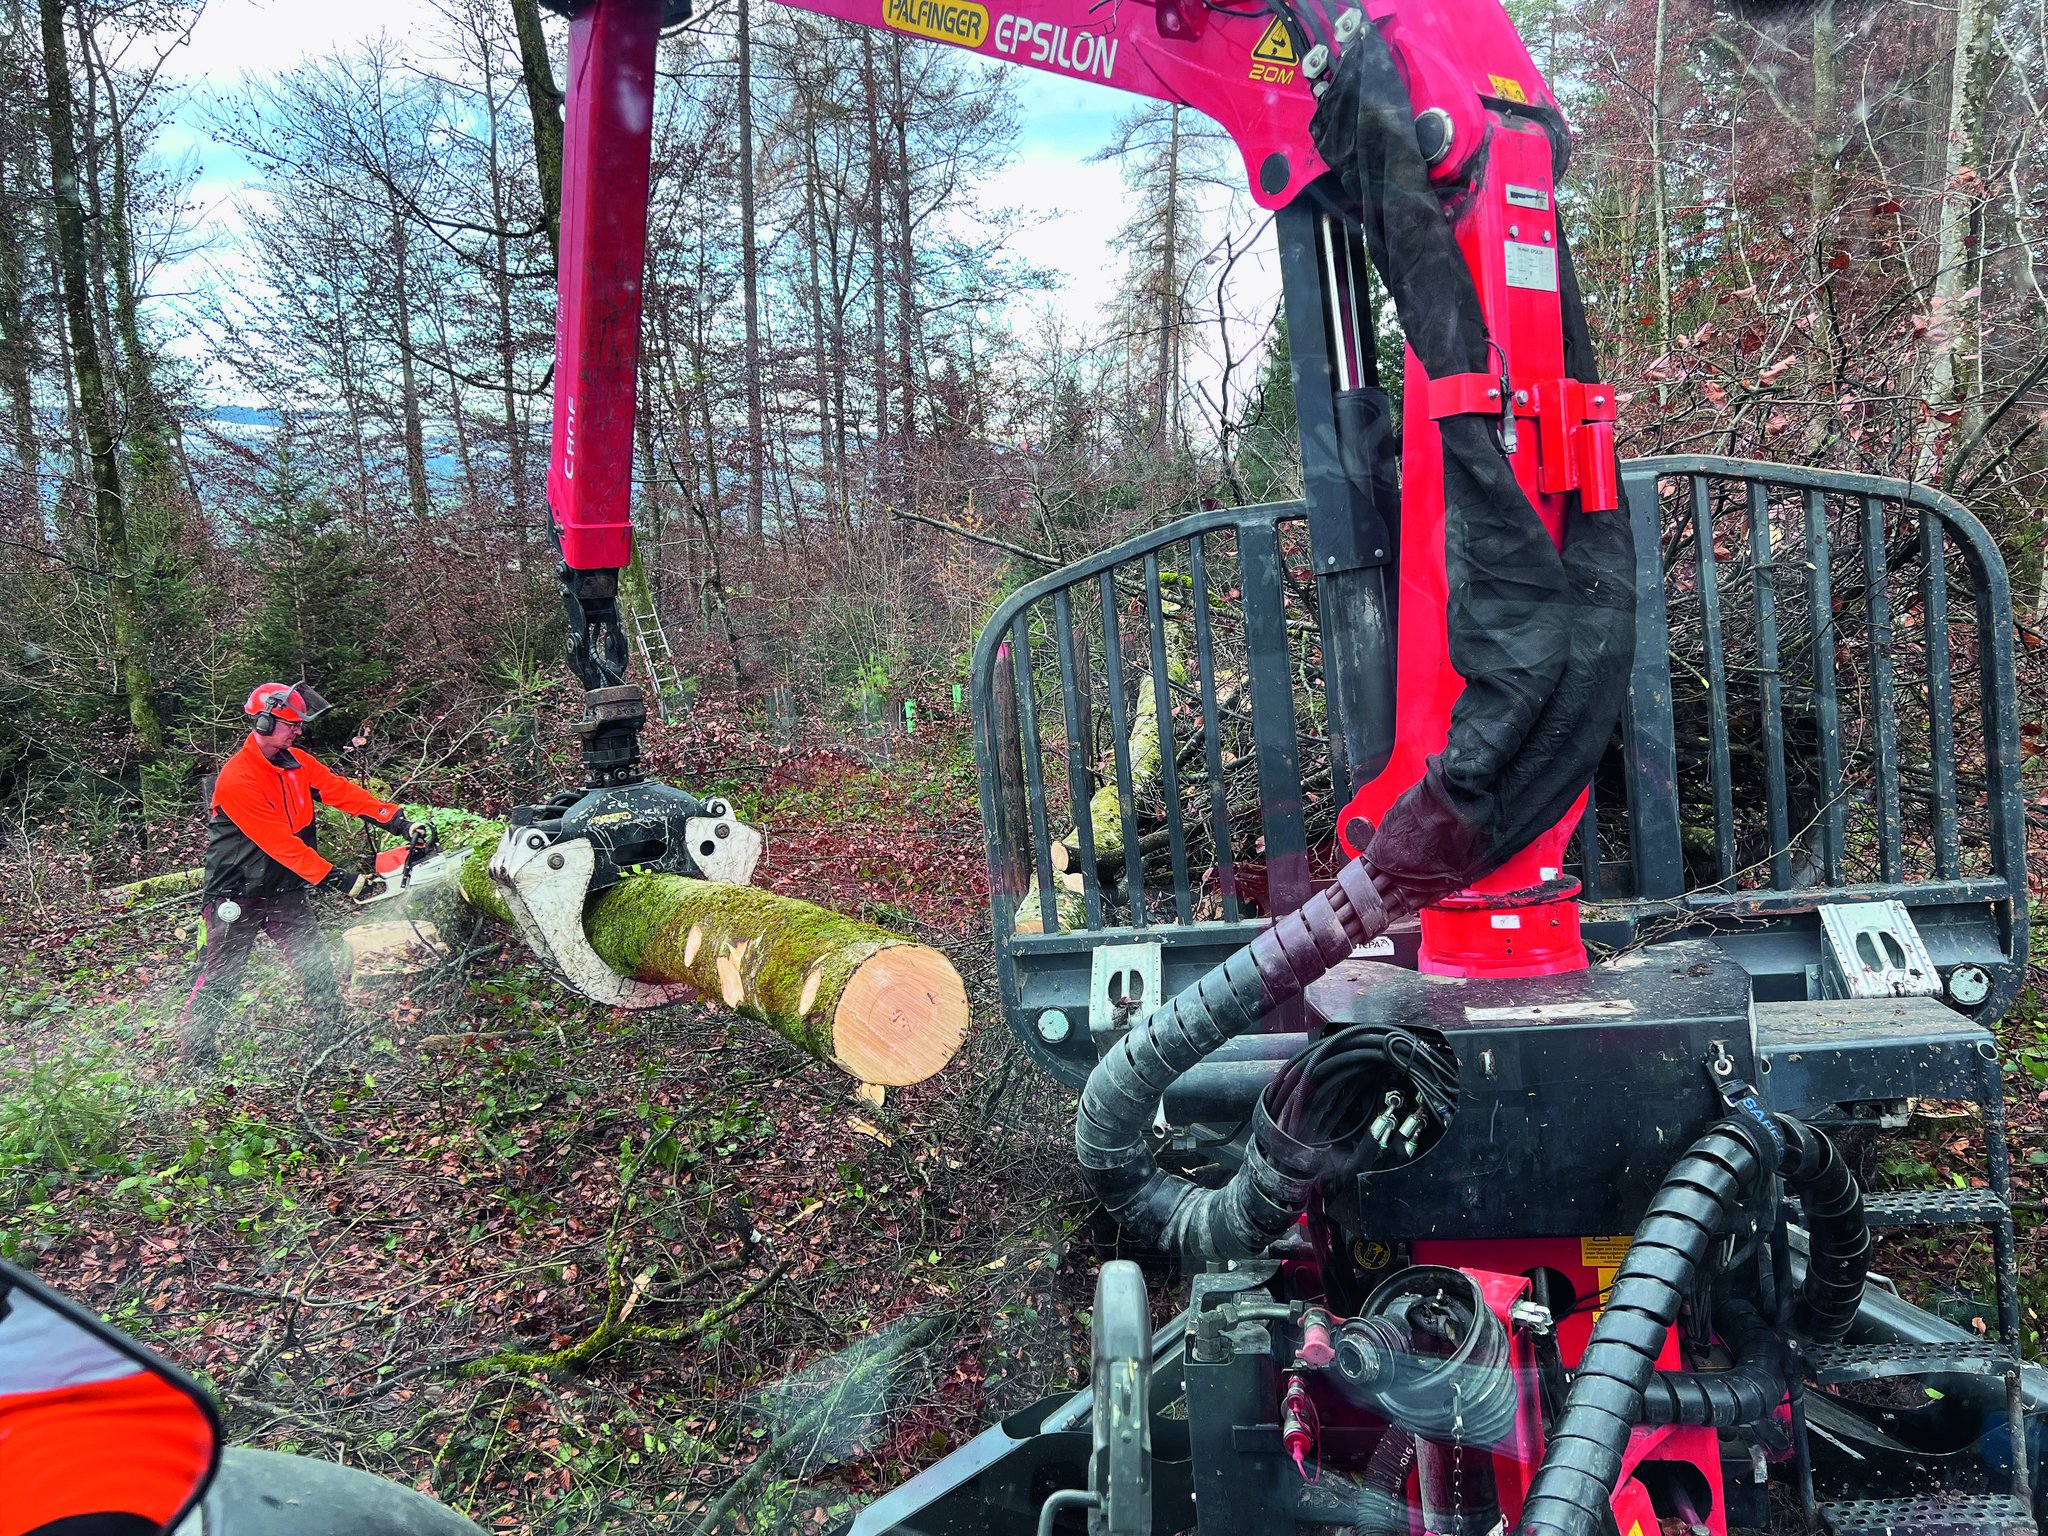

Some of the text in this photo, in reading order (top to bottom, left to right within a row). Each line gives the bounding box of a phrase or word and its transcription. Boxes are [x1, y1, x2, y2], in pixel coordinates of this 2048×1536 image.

[888, 0, 1119, 79] PALFINGER EPSILON
[1249, 63, 1294, 85] 20M
